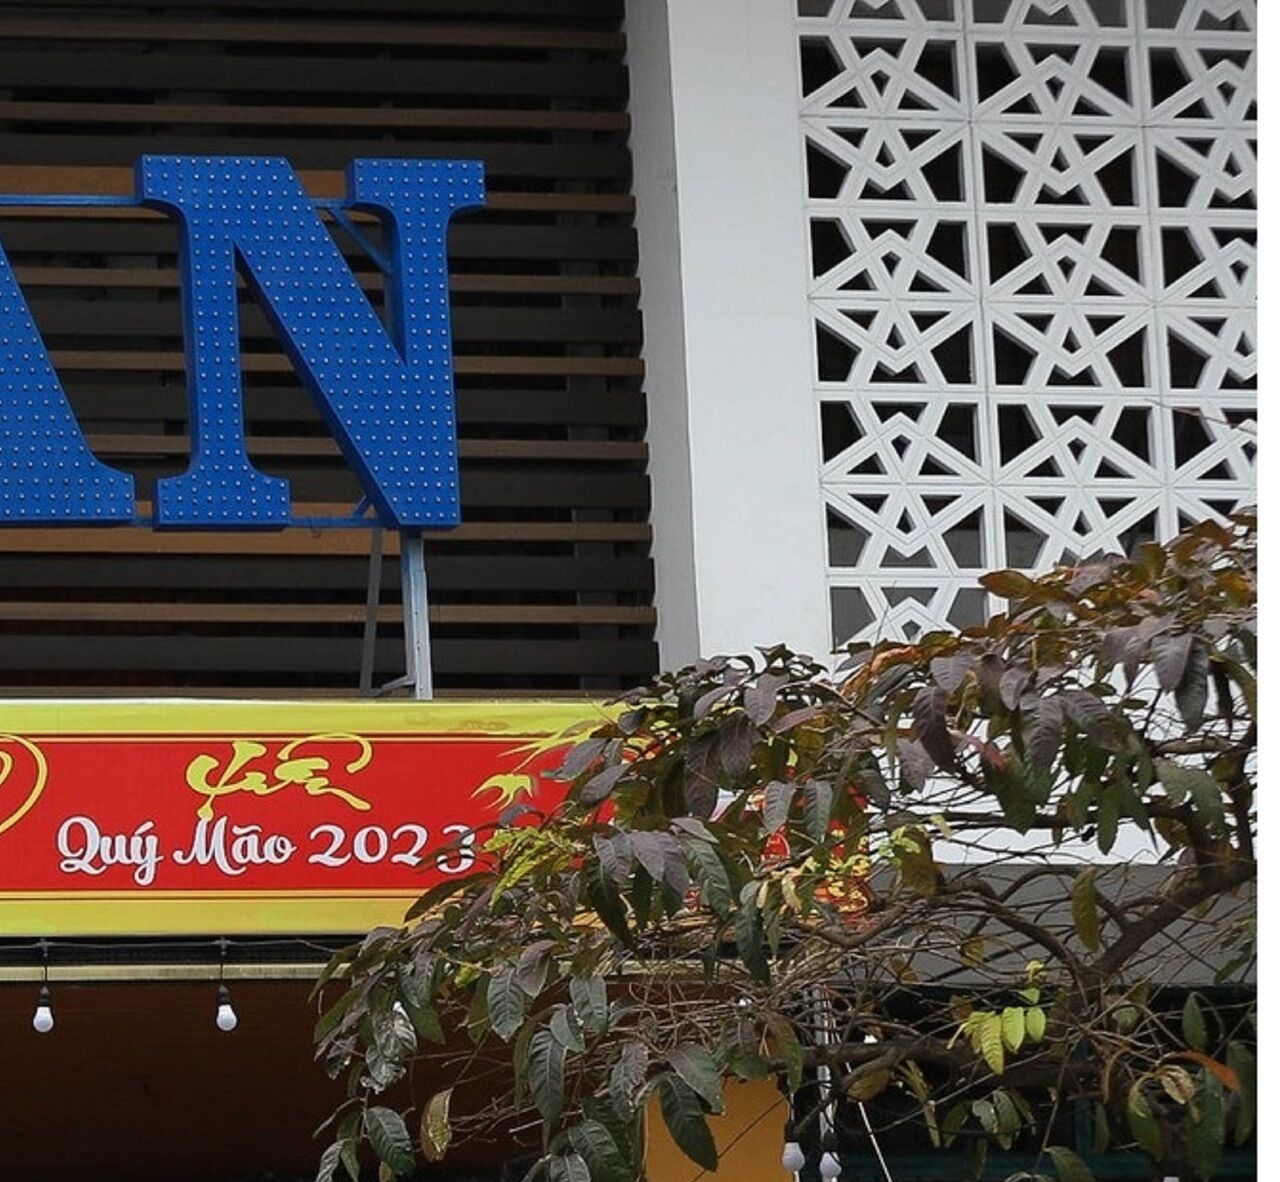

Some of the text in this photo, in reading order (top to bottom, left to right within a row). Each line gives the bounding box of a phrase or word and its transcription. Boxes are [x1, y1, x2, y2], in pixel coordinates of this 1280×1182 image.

[57, 815, 477, 887] Quý Mão 2023
